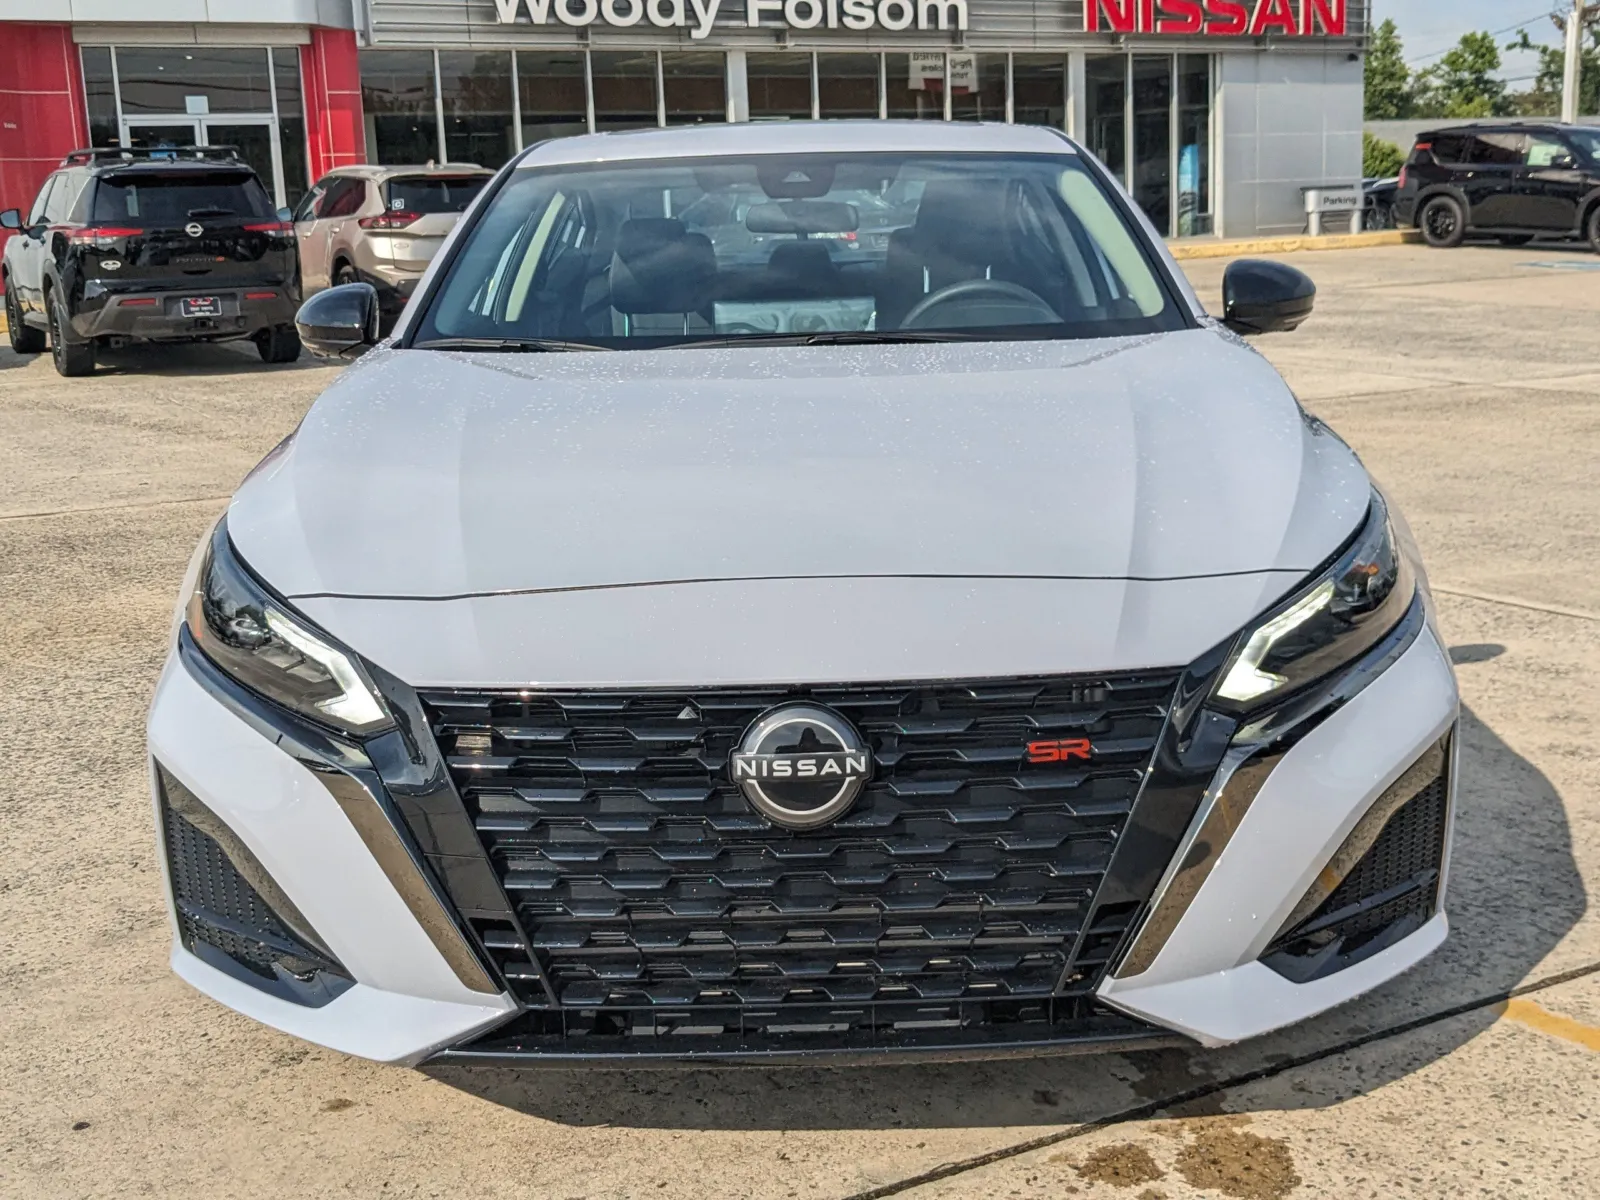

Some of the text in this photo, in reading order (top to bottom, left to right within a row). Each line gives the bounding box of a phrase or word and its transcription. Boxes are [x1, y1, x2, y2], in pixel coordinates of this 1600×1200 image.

[747, 0, 969, 31] Folsom
[1083, 0, 1348, 36] NISSAN
[1323, 196, 1357, 206] Parking
[1027, 737, 1091, 763] SR
[736, 755, 866, 777] NISSAN
